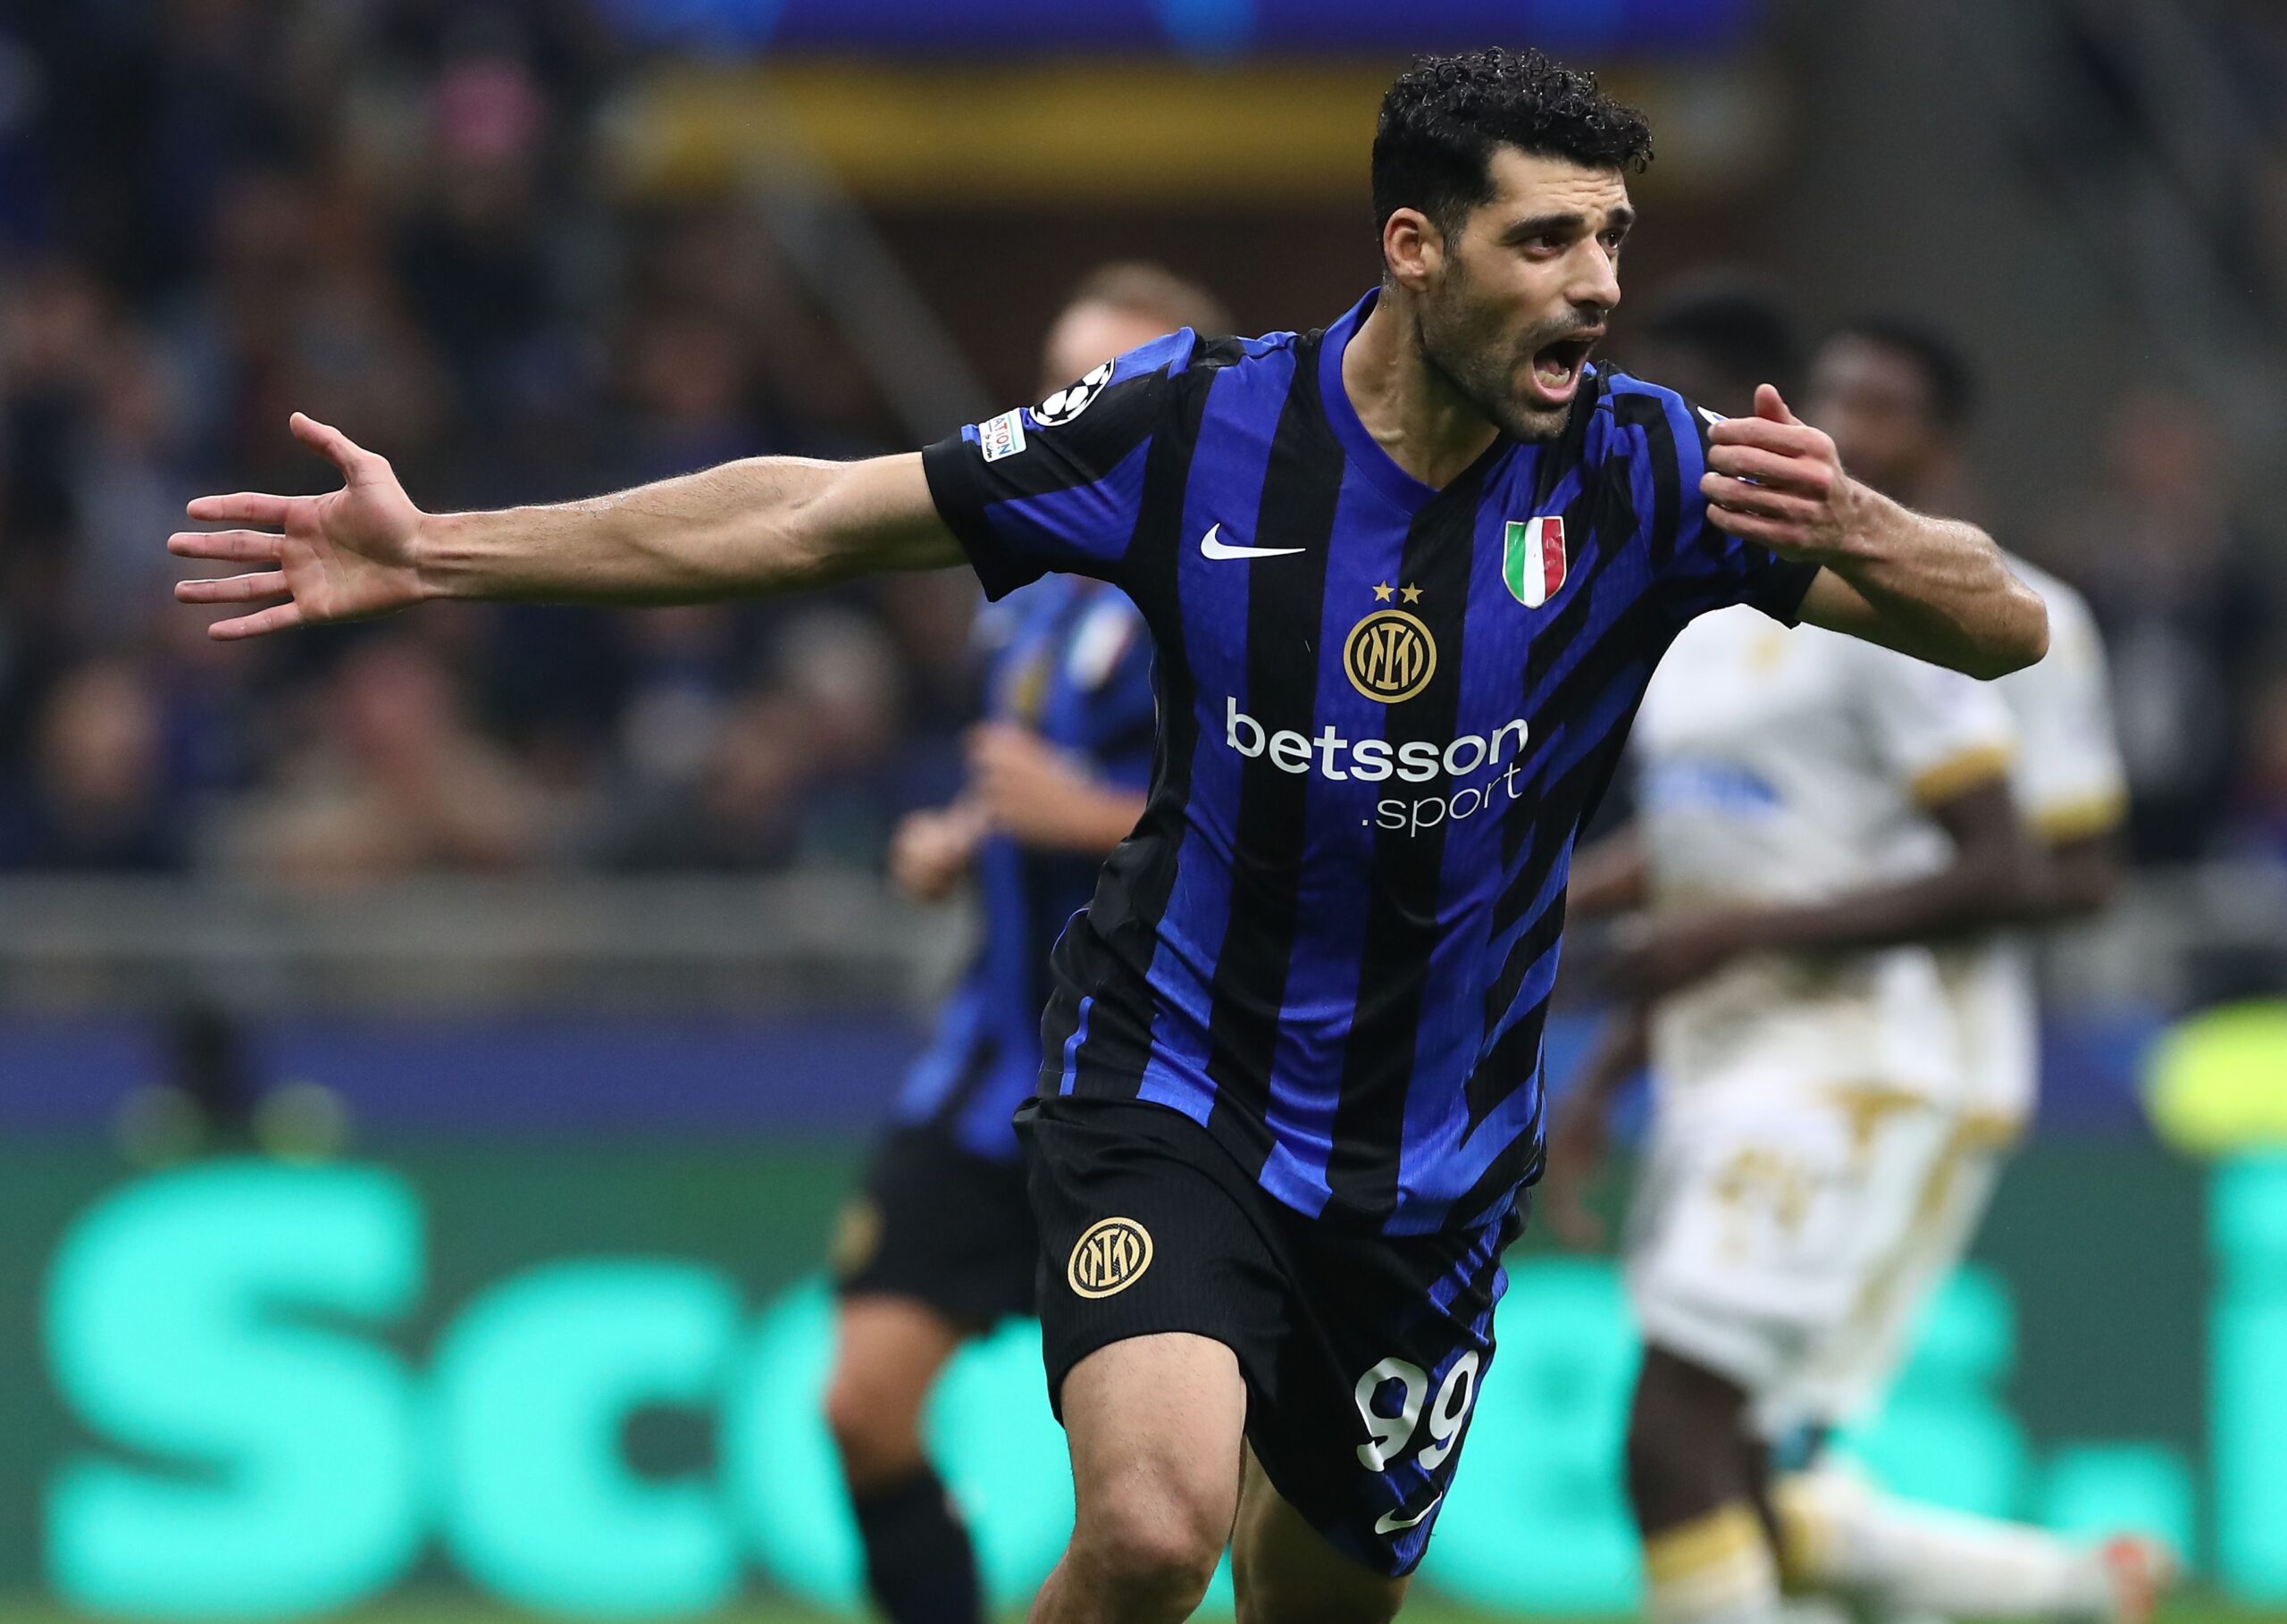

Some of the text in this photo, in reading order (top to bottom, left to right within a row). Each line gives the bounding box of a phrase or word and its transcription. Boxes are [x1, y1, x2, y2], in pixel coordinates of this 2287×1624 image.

[1226, 695, 1529, 783] betsson
[1361, 761, 1524, 838] .sport
[1354, 1349, 1479, 1472] 99
